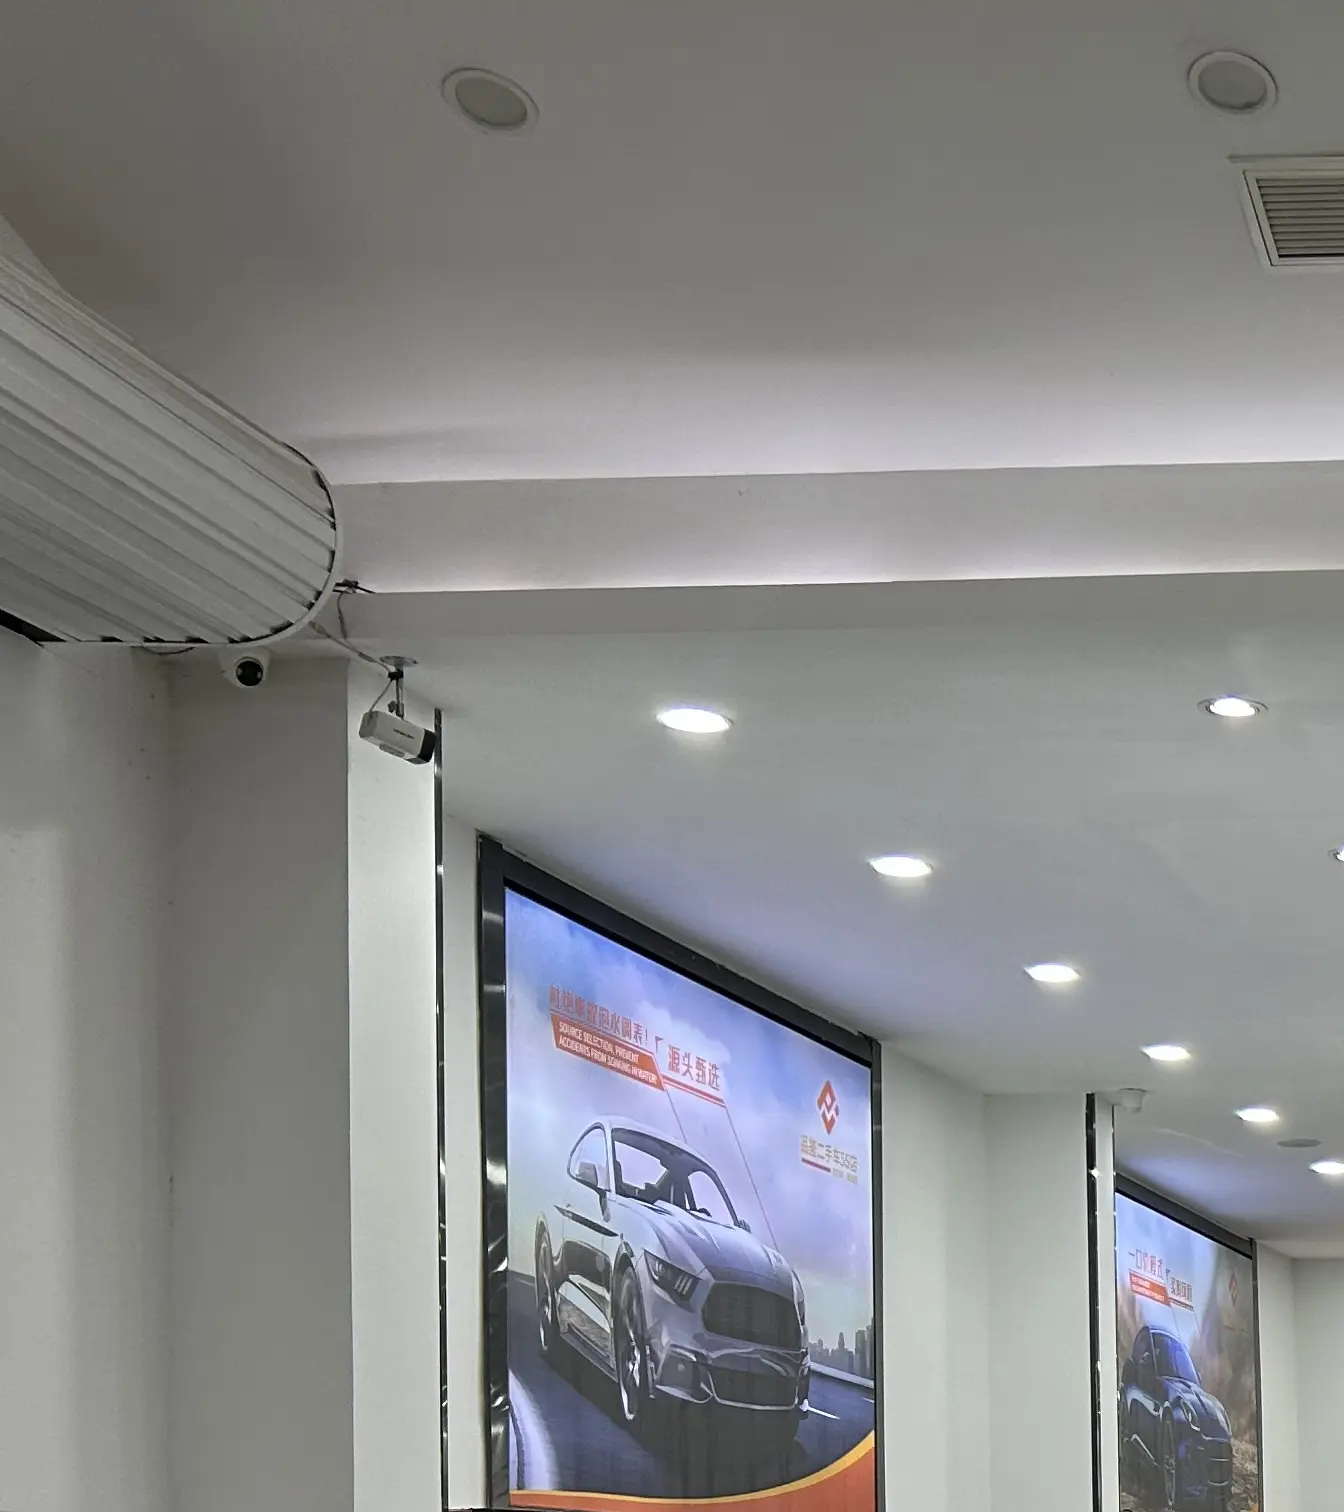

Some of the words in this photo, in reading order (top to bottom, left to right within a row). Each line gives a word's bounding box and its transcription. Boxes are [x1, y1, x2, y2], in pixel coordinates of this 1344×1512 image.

[559, 1021, 583, 1040] SOURCE
[615, 1045, 639, 1063] PREVENT
[559, 1035, 591, 1056] ACCIDENTS
[590, 1047, 607, 1063] FROM
